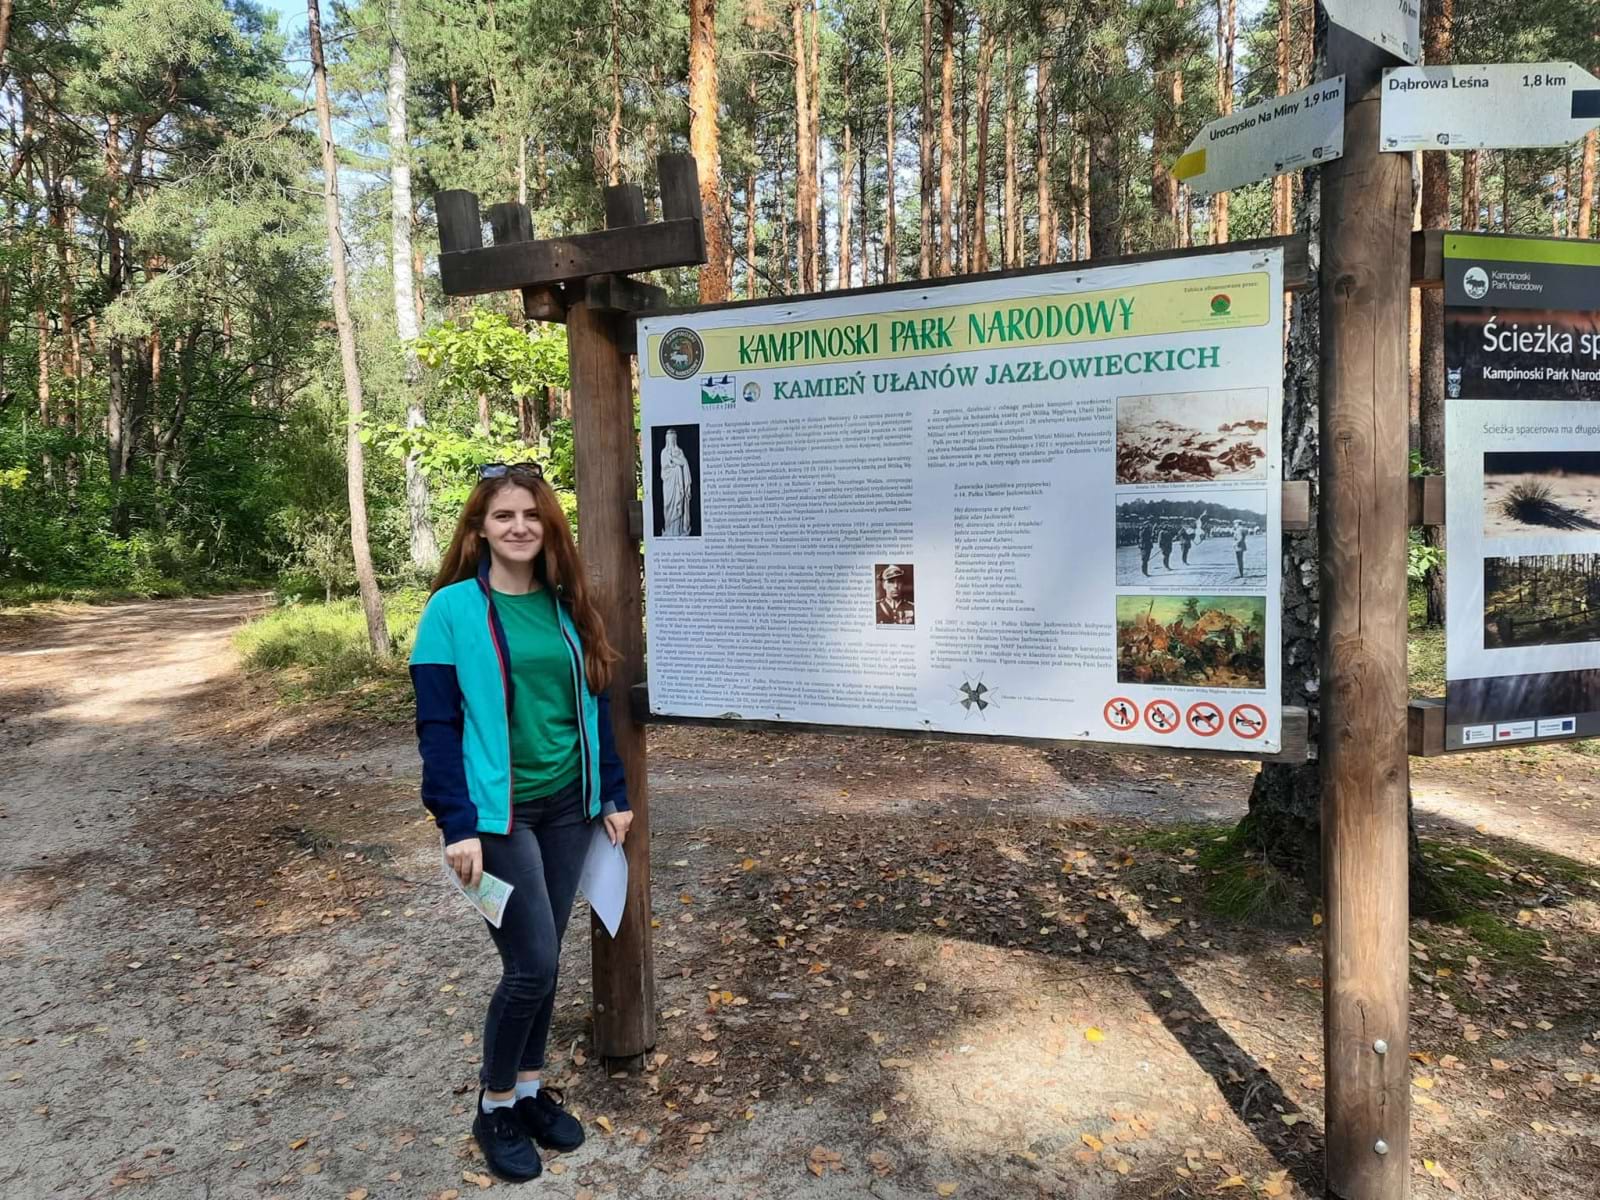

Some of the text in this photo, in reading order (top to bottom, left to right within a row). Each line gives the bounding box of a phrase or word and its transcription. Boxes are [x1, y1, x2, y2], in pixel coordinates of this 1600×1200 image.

[1389, 74, 1566, 92] Dąbrowa Leśna 1,8 km
[1210, 88, 1339, 141] Uroczysko Na Miny 1,9 km
[1492, 271, 1531, 281] Kampinoski
[1492, 280, 1544, 293] Park Narodowy
[738, 296, 1135, 364] KAMPINOSKI PARK NARODOWY
[1482, 315, 1573, 353] Ścieżka
[773, 346, 1221, 400] KAMIEŃ UŁANÓW JAZŁOWIECKICH
[1483, 366, 1544, 381] Kampinoski
[1546, 367, 1569, 380] Park
[1483, 422, 1514, 434] Ścieżka
[1516, 425, 1559, 436] spacerowa
[1561, 426, 1571, 434] ma
